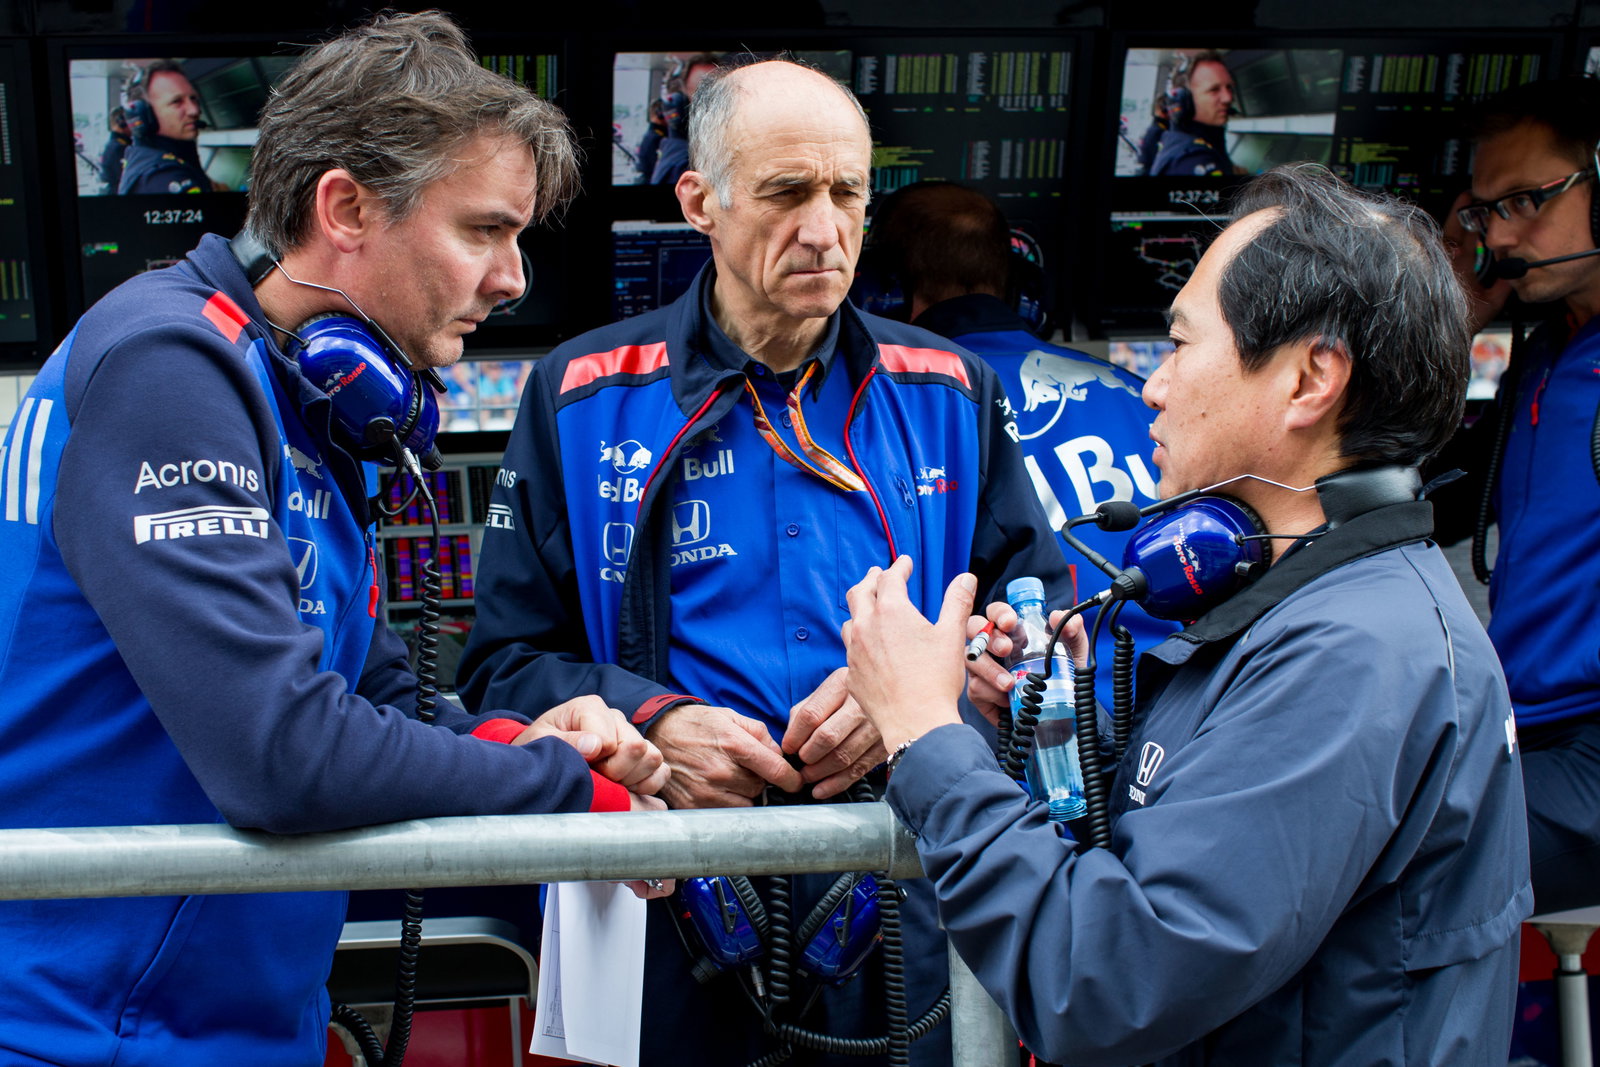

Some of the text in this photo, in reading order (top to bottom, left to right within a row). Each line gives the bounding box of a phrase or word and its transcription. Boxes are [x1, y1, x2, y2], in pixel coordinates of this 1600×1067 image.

[143, 209, 203, 224] 12:37:24
[340, 362, 367, 386] Rosso
[134, 459, 260, 494] Acronis
[684, 449, 735, 481] Bull
[134, 505, 271, 545] PIRELLI
[671, 543, 738, 567] ONDA
[1183, 565, 1204, 595] Rosso
